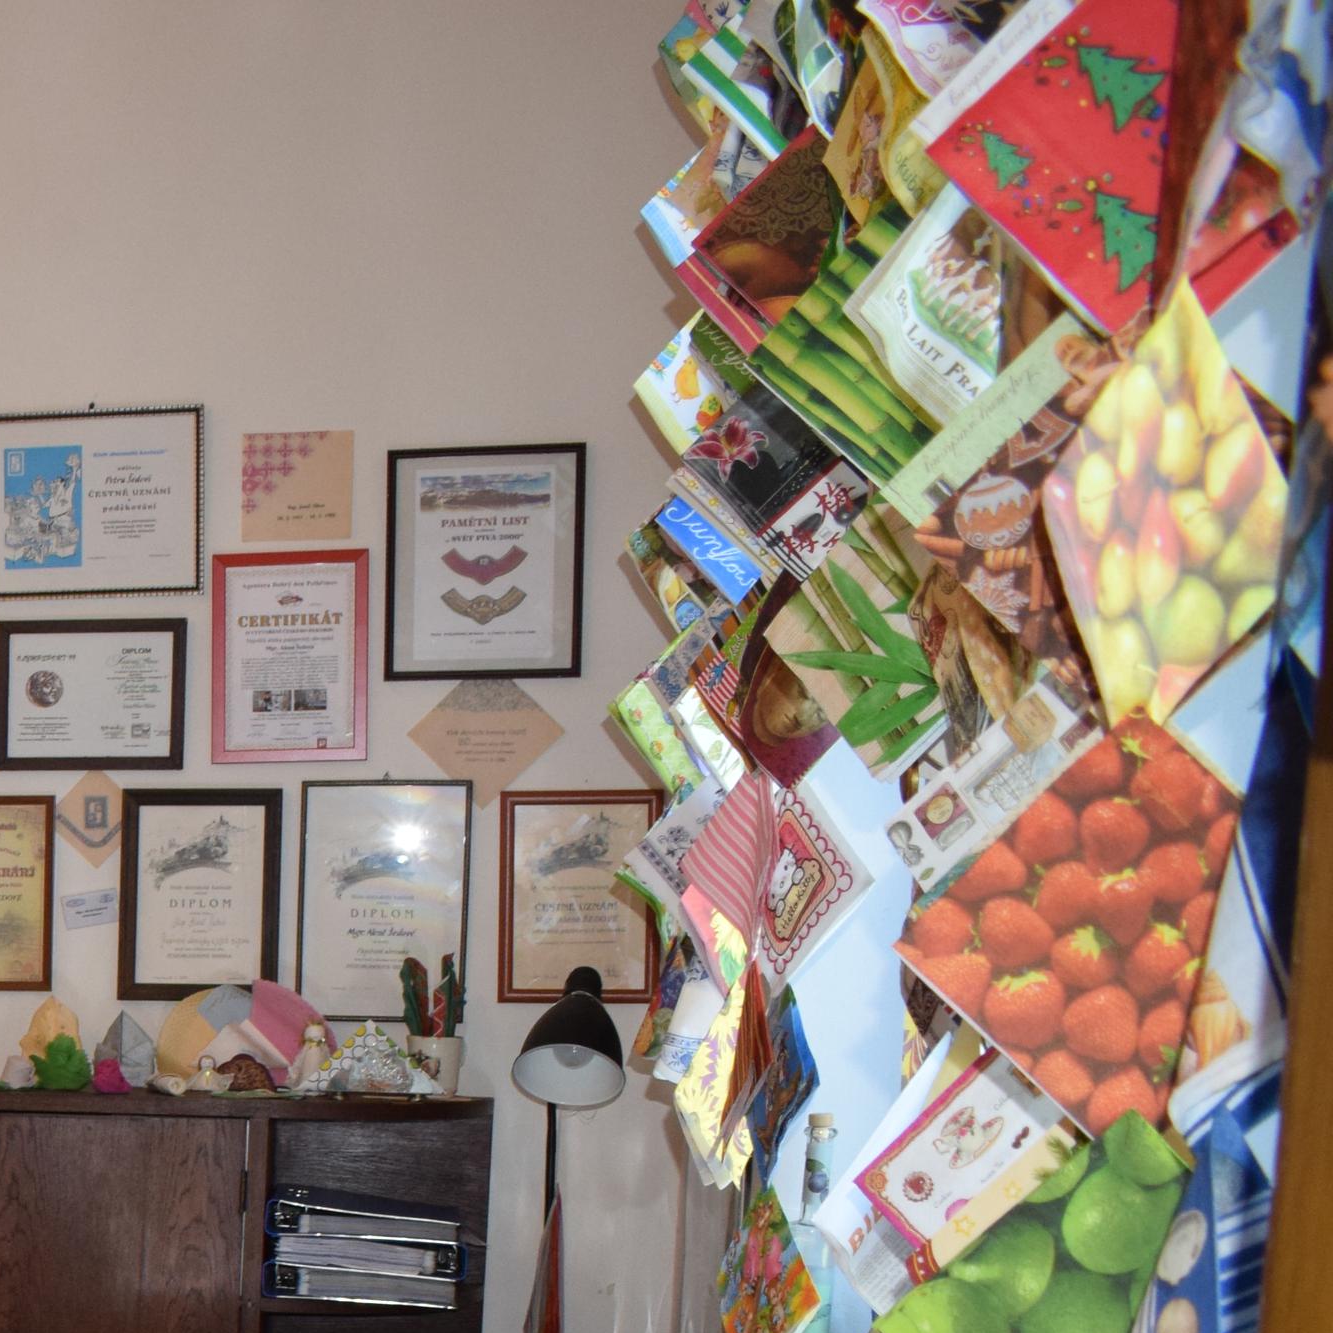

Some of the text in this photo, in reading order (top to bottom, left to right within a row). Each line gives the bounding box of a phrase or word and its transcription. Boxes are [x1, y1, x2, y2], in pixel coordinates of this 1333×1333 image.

[88, 486, 171, 498] ČESTNÉ UZNÁNÍ
[440, 516, 531, 528] PAMĚTNÍ LIST
[237, 610, 343, 628] CERTIFIKÁT
[794, 869, 818, 903] Kitty
[169, 899, 232, 908] DIPLOM
[351, 908, 413, 919] DIPLOM
